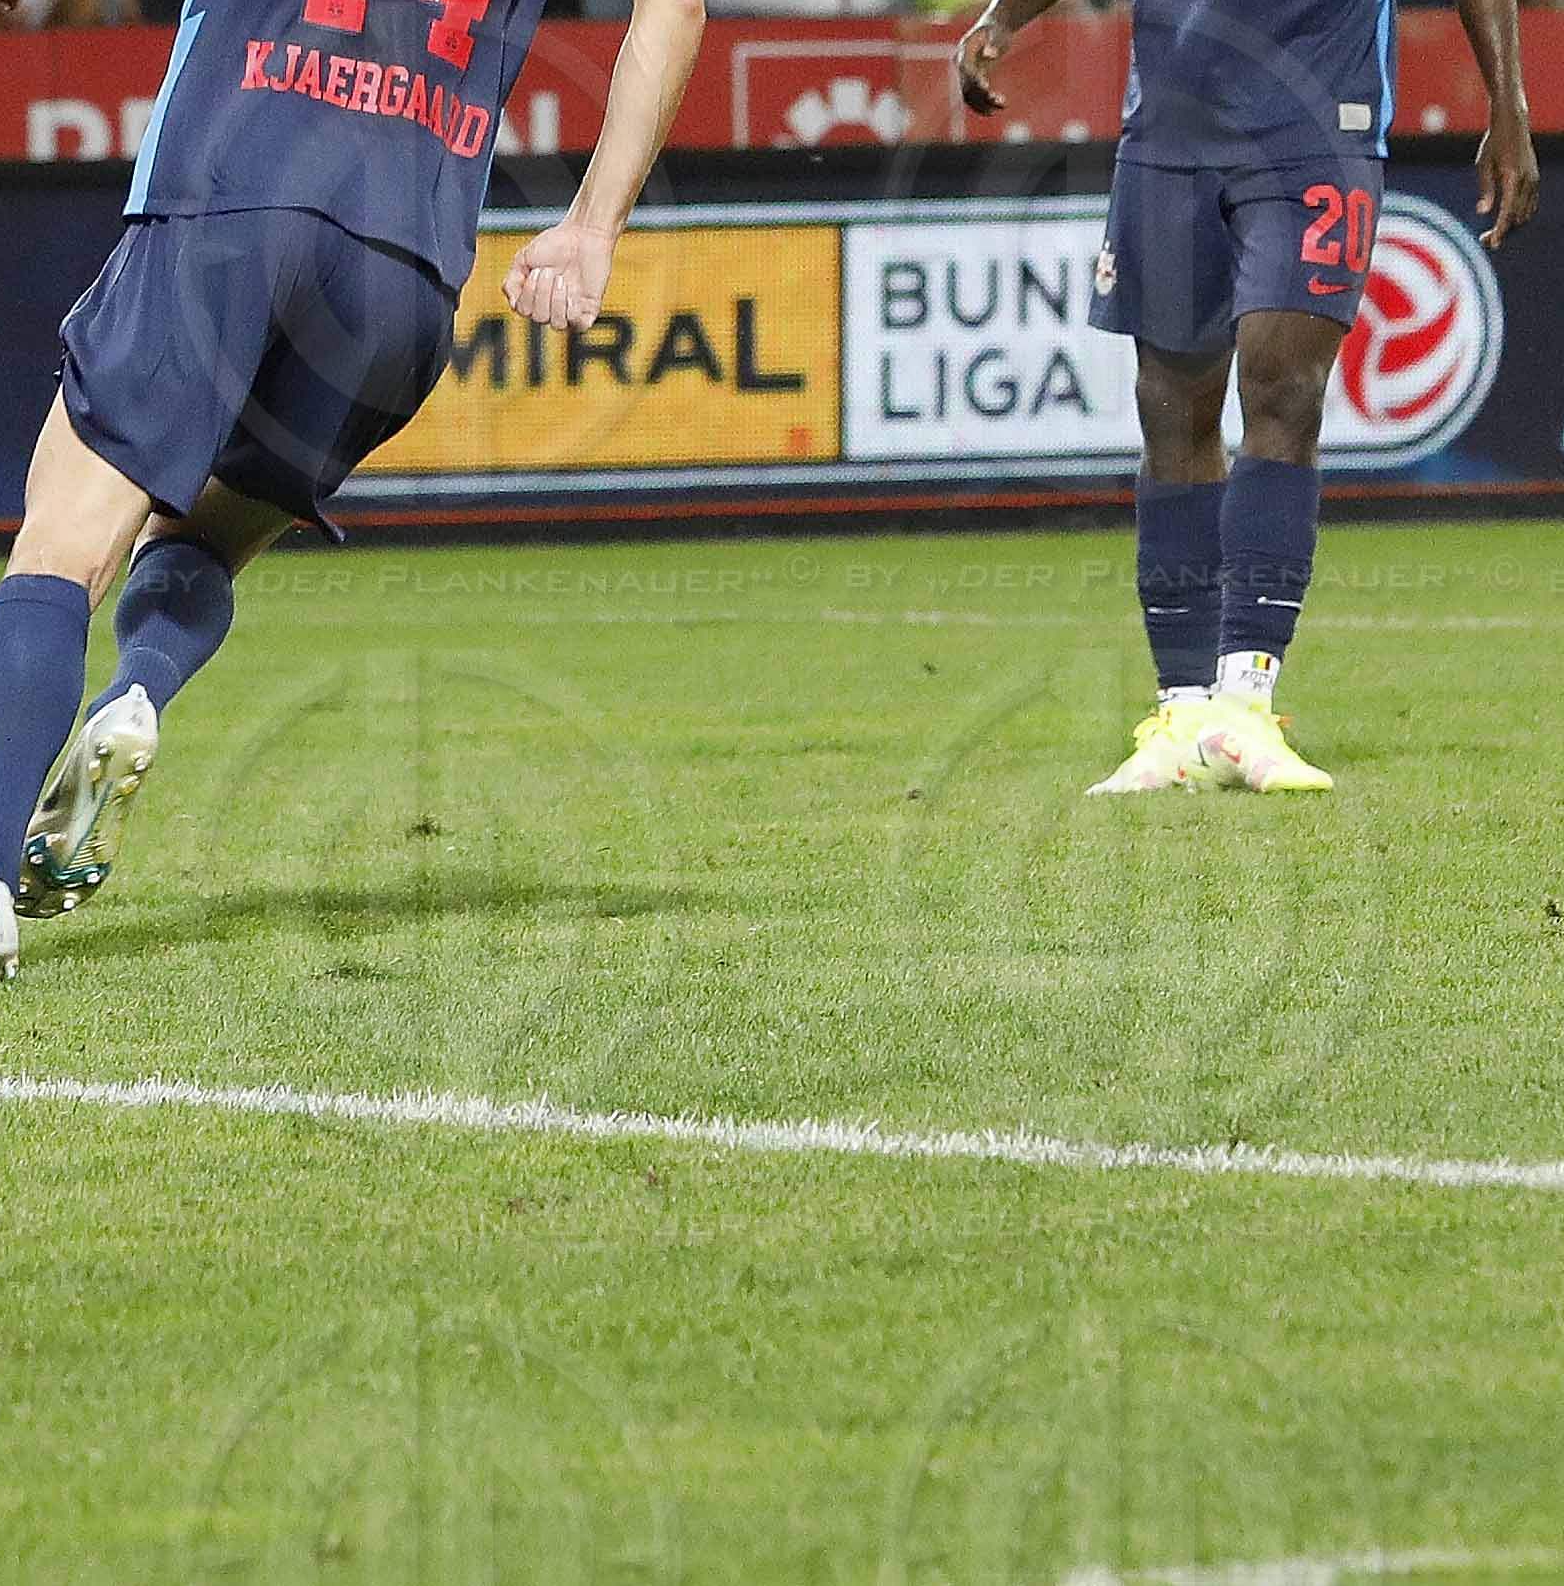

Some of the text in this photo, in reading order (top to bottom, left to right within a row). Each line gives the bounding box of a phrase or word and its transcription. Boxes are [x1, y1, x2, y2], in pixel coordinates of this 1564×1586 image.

[1300, 184, 1373, 274] 20
[882, 256, 1096, 328] BUN
[448, 294, 807, 394] MIRAL
[882, 346, 1095, 419] LIGA
